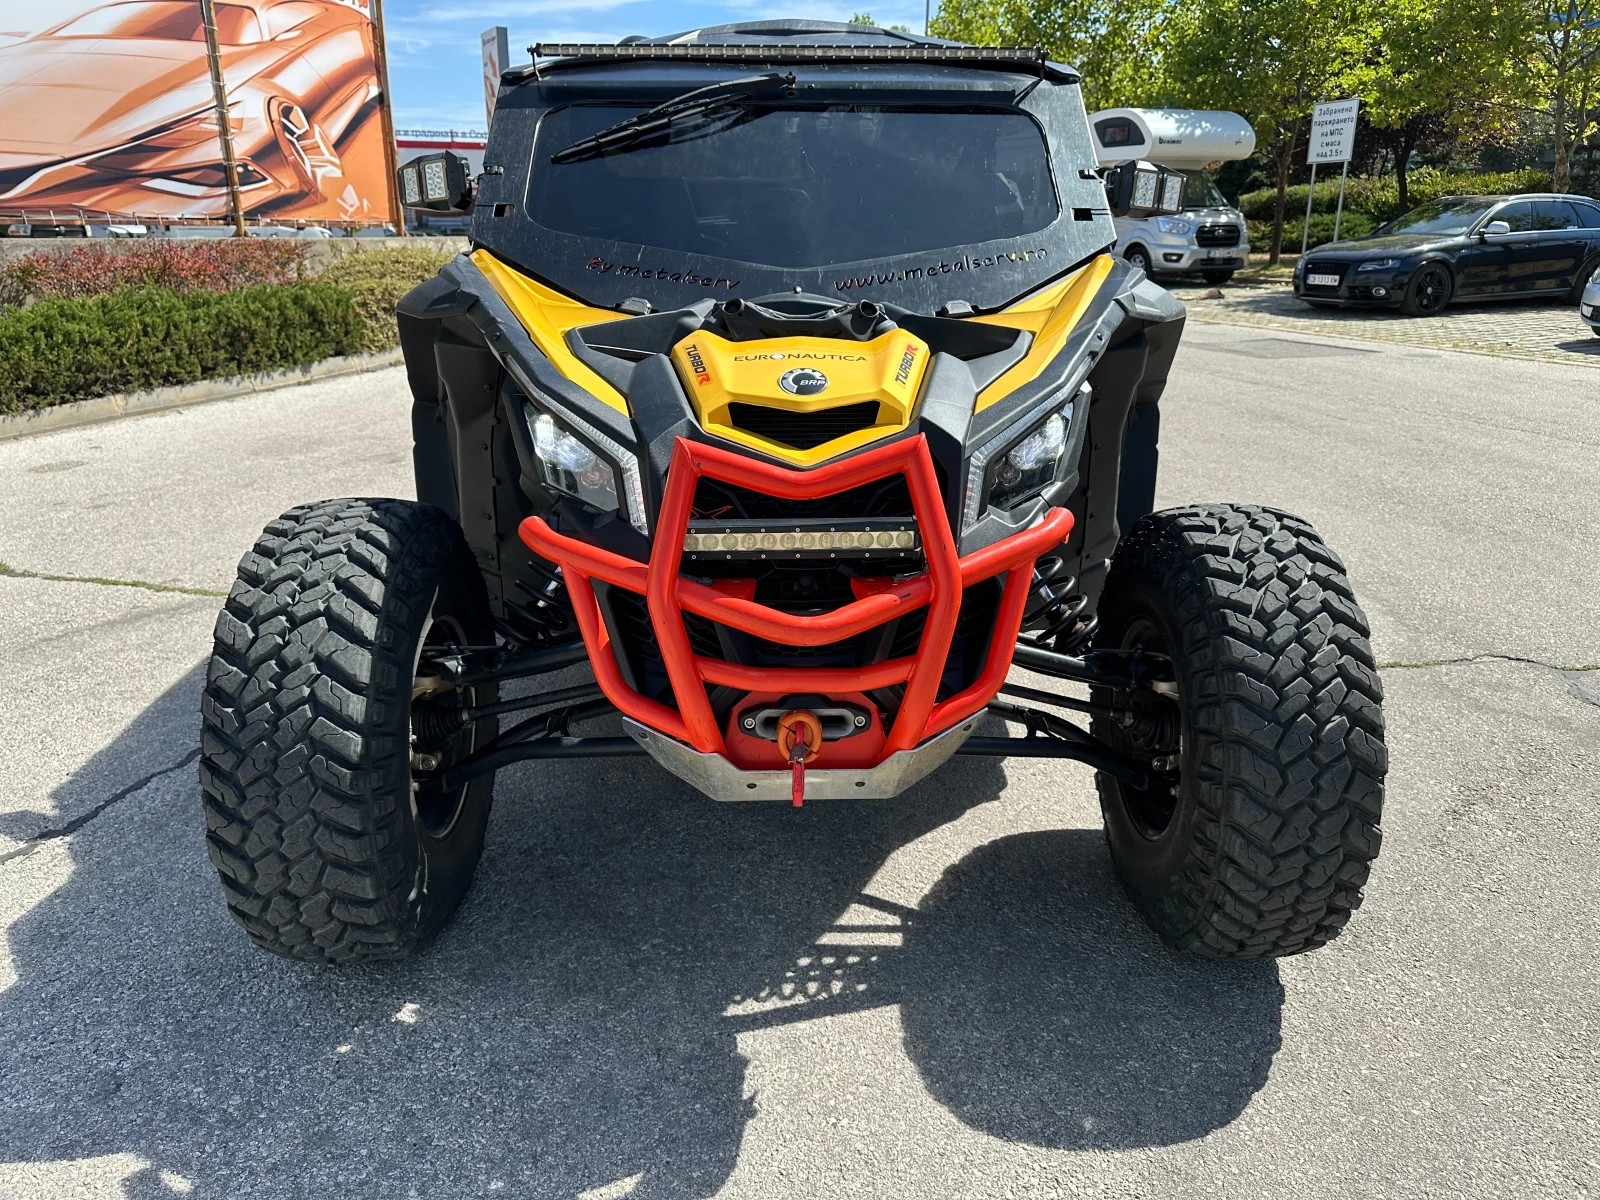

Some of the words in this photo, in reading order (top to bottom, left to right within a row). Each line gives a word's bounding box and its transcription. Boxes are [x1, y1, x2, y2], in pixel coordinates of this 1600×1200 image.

[1318, 106, 1353, 116] Забранено
[1313, 116, 1354, 128] паркирането
[1329, 127, 1344, 136] МПС
[834, 248, 1048, 292] www.metalserv.ro
[615, 264, 741, 290] metalserv
[733, 353, 868, 362] EURONAUTICA
